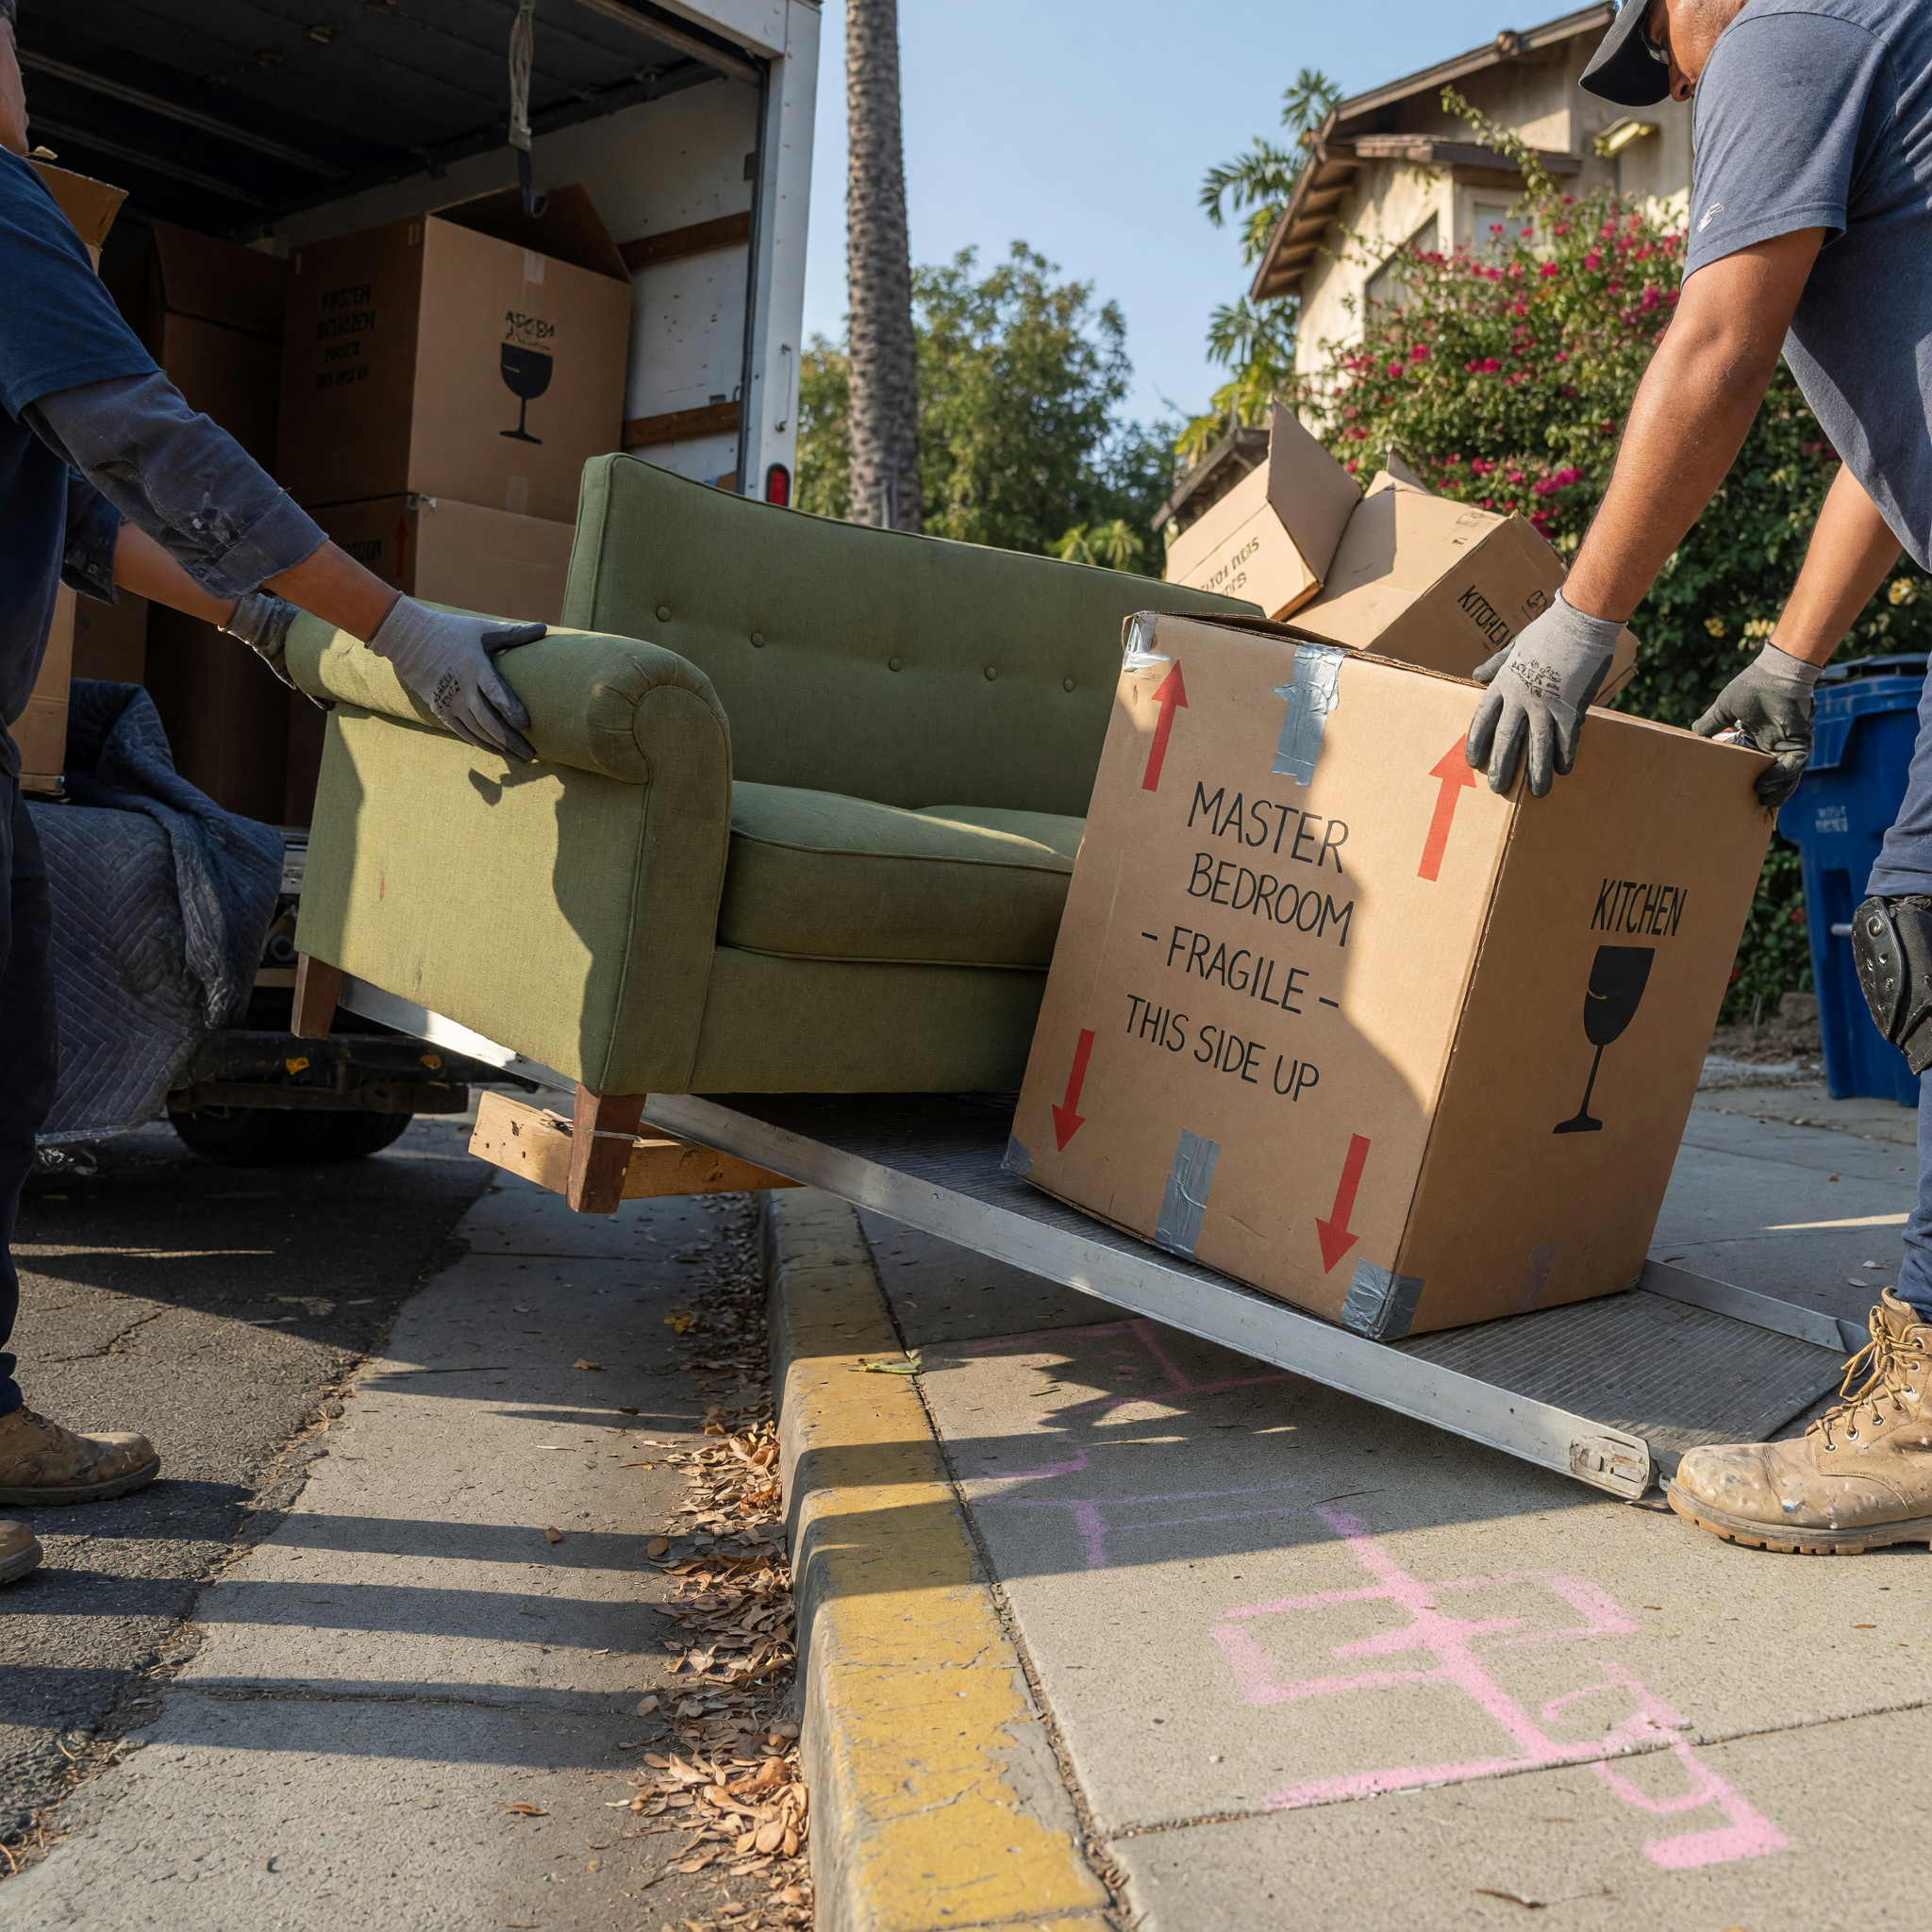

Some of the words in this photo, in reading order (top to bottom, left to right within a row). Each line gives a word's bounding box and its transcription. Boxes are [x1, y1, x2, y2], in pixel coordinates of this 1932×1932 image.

[1187, 781, 1349, 874] MASTER
[1186, 852, 1355, 947] BEDROOM
[1590, 877, 1689, 937] KITCHEN
[1166, 925, 1310, 1015] FRAGILE
[1126, 993, 1190, 1053] THIS
[1193, 1024, 1266, 1085] SIDE
[1274, 1055, 1320, 1103] UP
